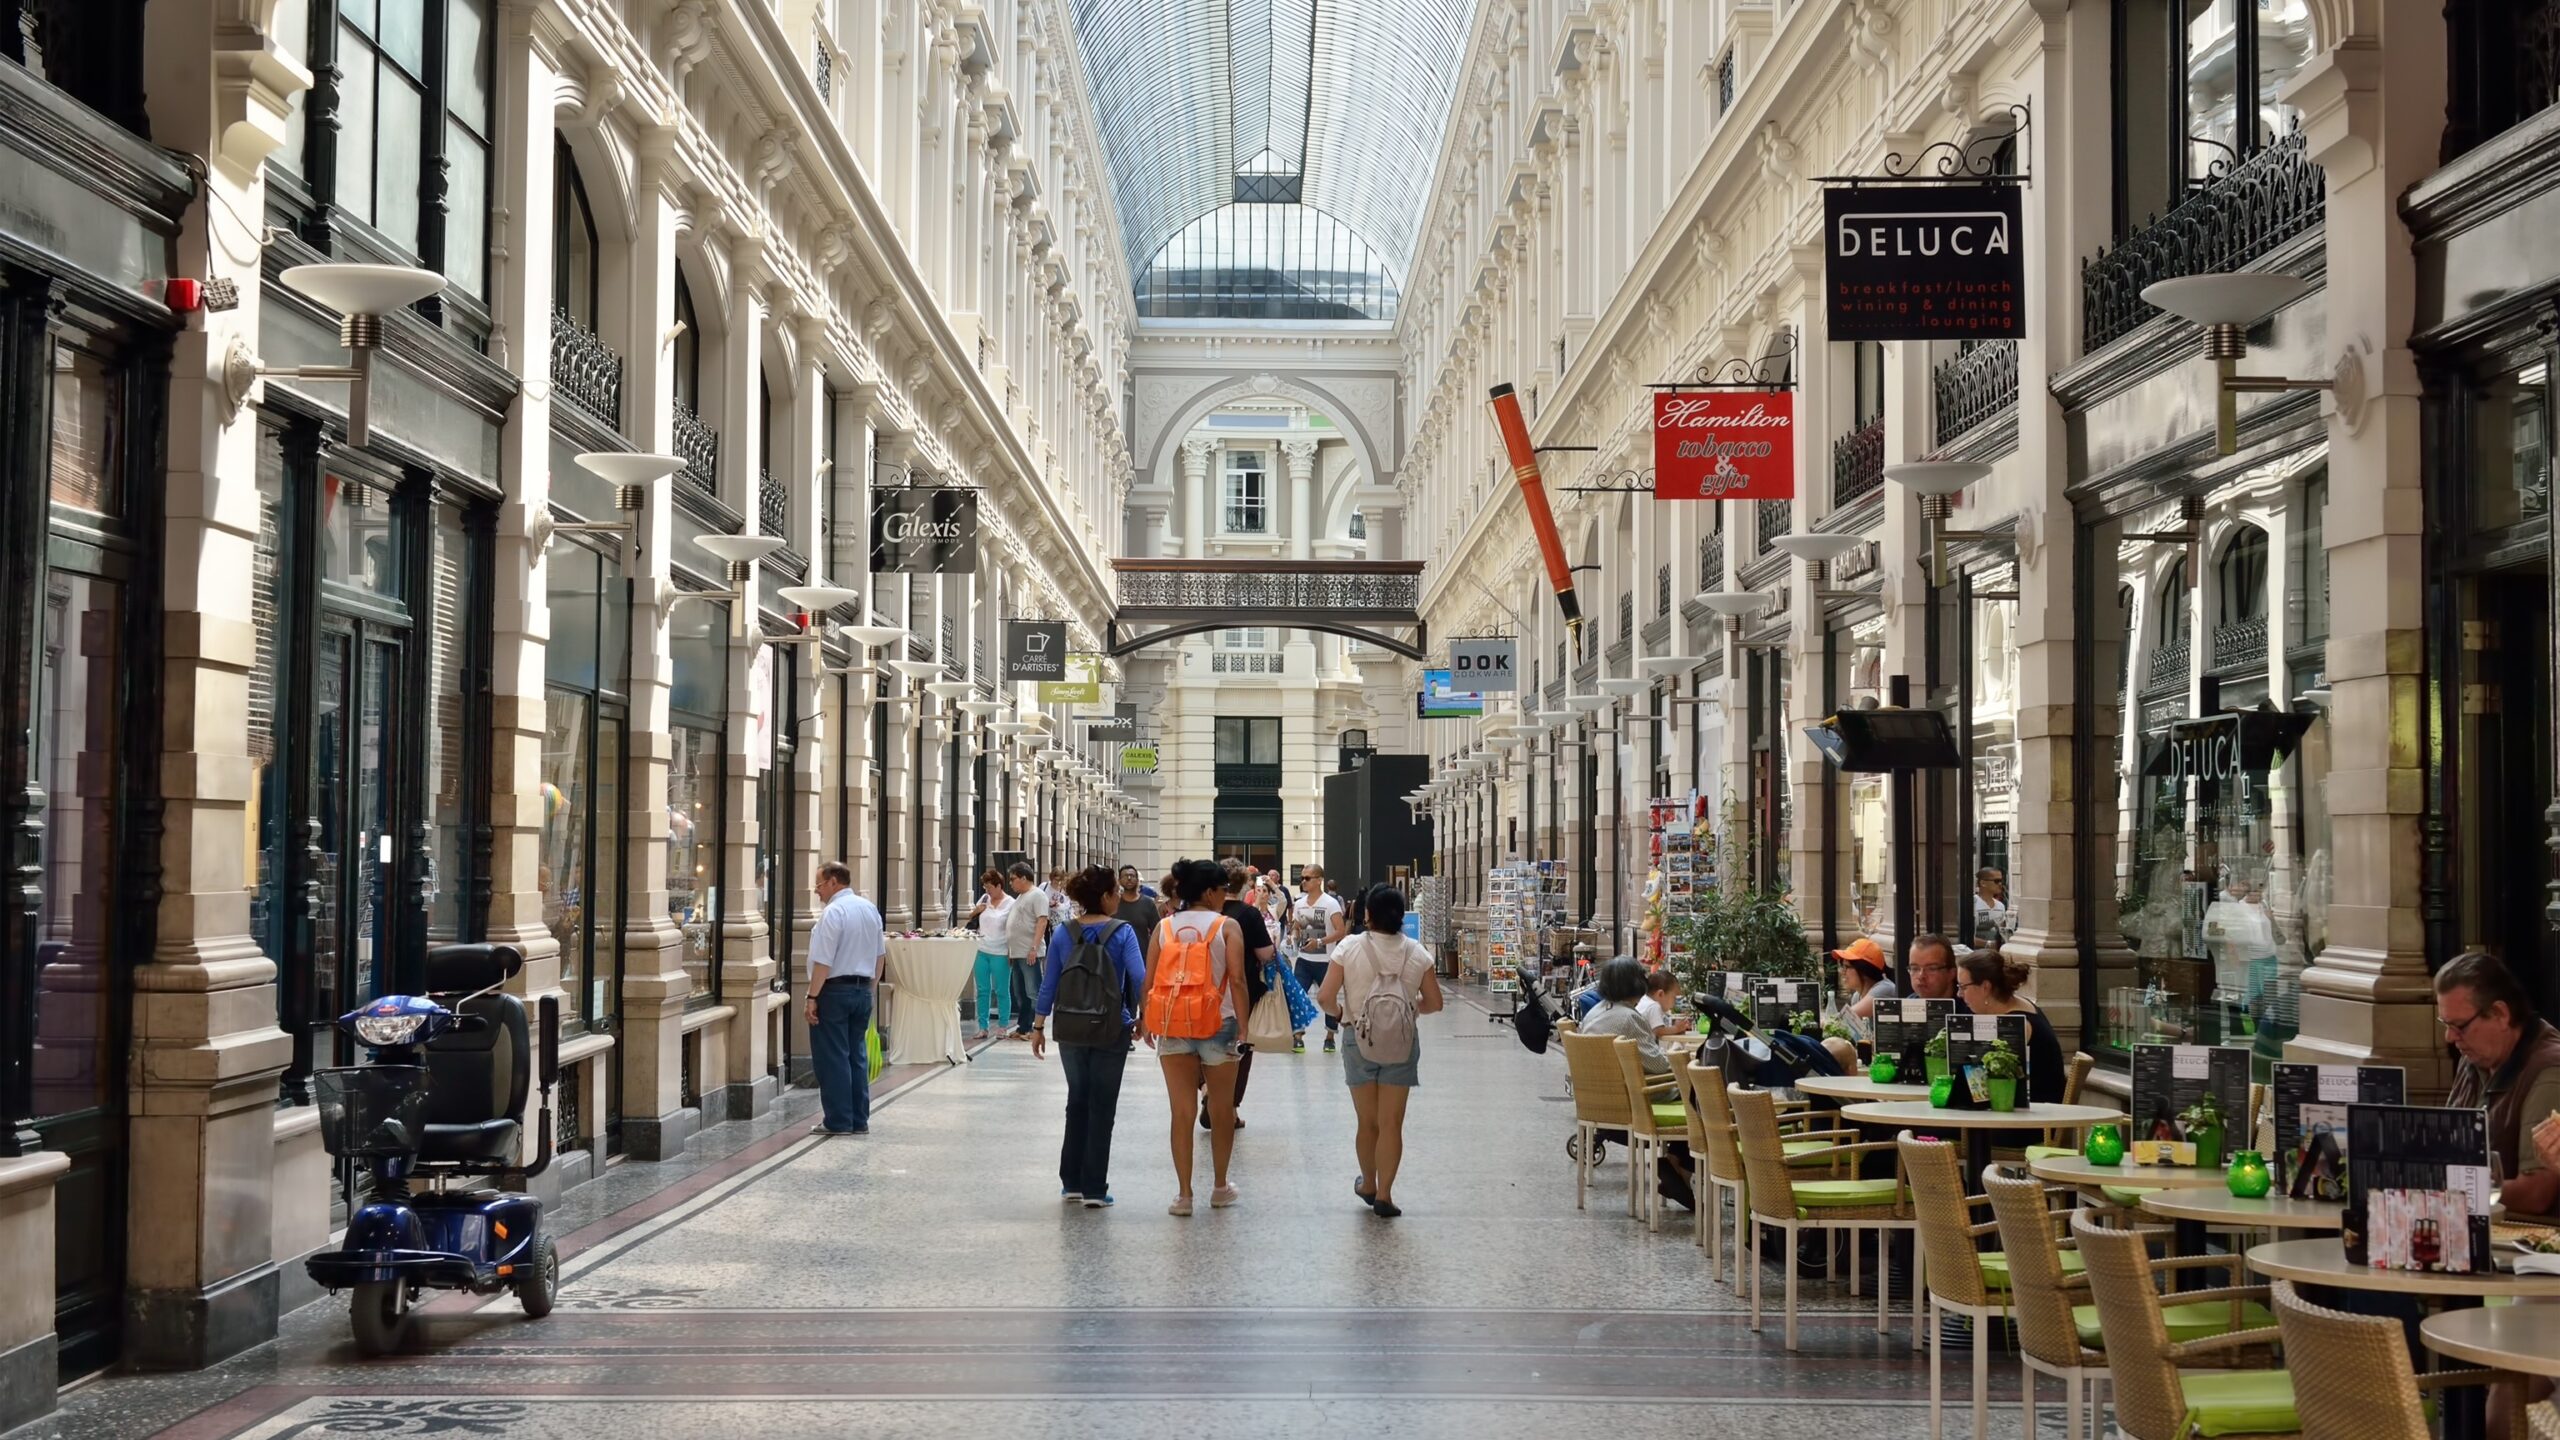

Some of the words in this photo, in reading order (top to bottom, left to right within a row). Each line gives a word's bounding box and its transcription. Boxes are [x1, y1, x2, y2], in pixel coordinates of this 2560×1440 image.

[1839, 219, 2009, 257] DELUCA
[1840, 281, 2011, 295] breakfast/lunch
[1841, 301, 1908, 313] wining
[1923, 300, 1933, 311] &
[1948, 299, 2012, 312] dining
[1657, 399, 1791, 428] Hamilton
[1676, 433, 1772, 458] tobacco
[1715, 456, 1731, 476] &
[1700, 466, 1749, 495] gifts
[882, 512, 961, 543] Calexis
[1022, 653, 1048, 663] CARRÉ
[1457, 654, 1509, 670] DOK
[1454, 670, 1513, 678] COOKWARE
[2171, 726, 2241, 784] DELUCA
